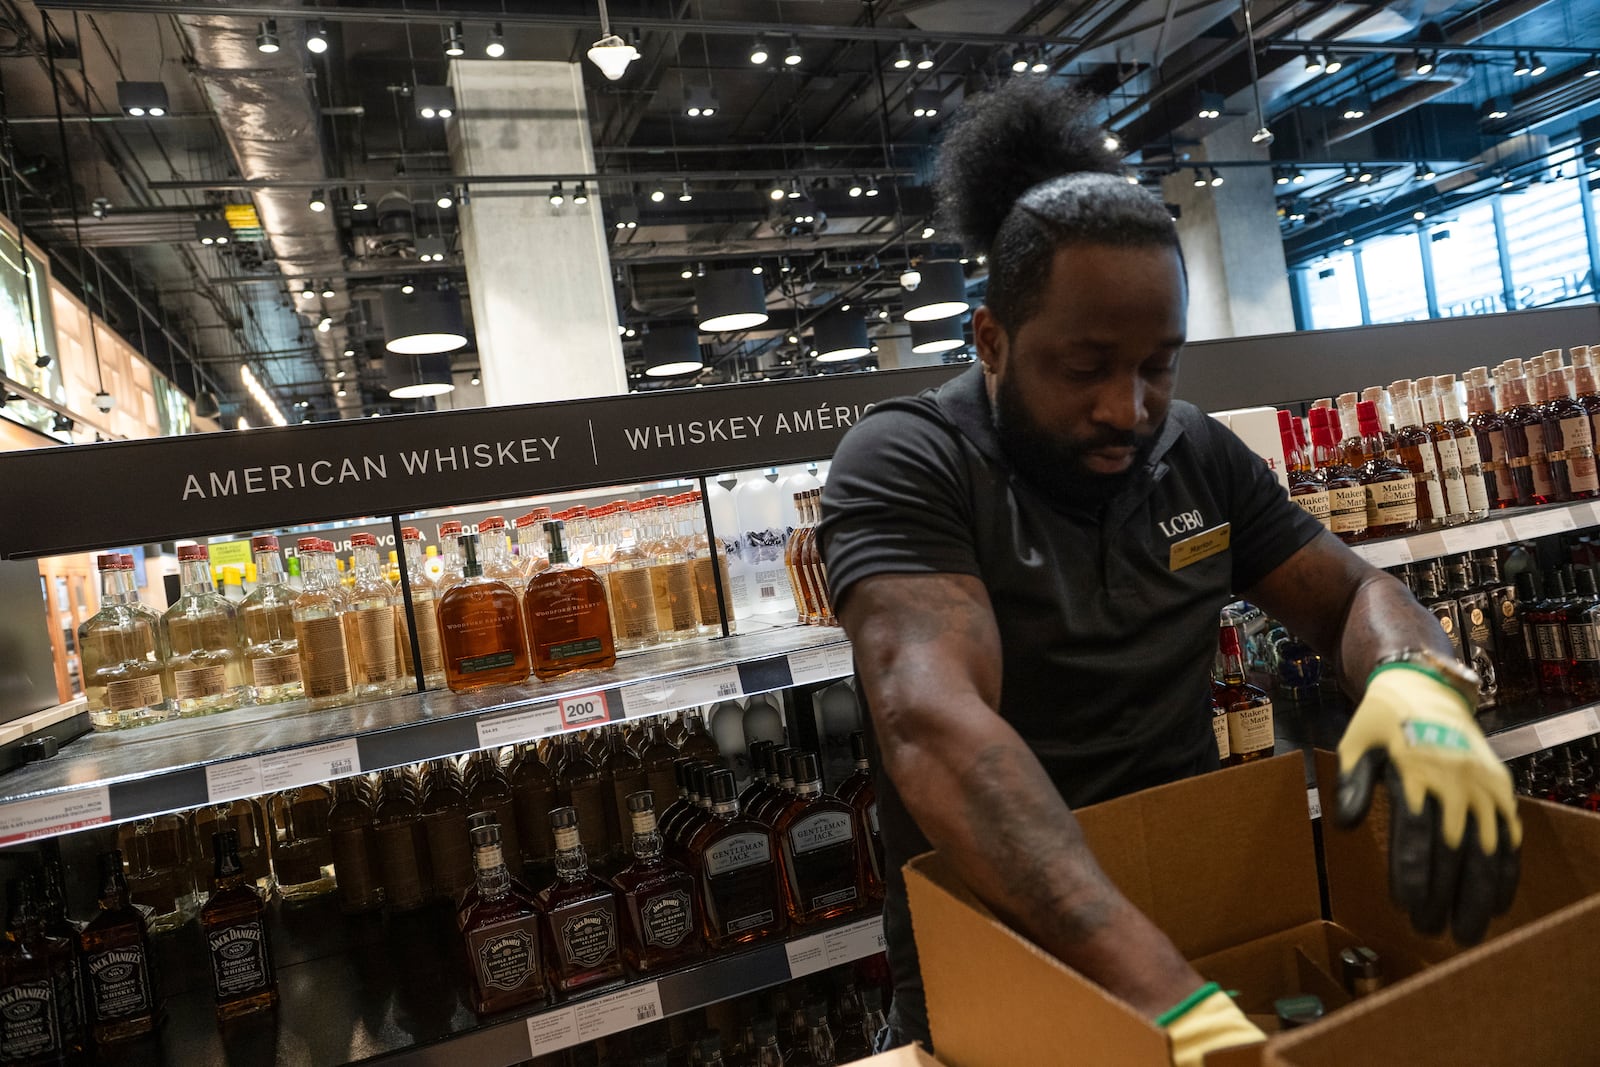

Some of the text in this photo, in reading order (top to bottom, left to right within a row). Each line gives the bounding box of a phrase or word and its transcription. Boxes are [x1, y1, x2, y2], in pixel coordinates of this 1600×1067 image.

[624, 414, 764, 450] WHISKEY
[182, 436, 560, 500] AMERICAN WHISKEY
[1297, 496, 1328, 505] Maker's
[1394, 490, 1416, 500] Mark
[1309, 504, 1329, 512] Mark
[1158, 509, 1204, 538] LCBO
[567, 702, 594, 718] 200
[1240, 708, 1269, 719] Maker's
[1249, 715, 1270, 725] Mark
[797, 820, 846, 838] GENTLEMAN
[814, 831, 833, 840] JACK
[712, 840, 764, 860] GENTLEMAN
[730, 852, 750, 861] JACK
[210, 928, 261, 950] JACK DANIEL'S
[221, 956, 256, 968] Tennessee
[508, 952, 528, 960] BARREL
[88, 952, 142, 974] JACK DANIEL'S
[224, 963, 256, 976] WHISKEY
[102, 988, 136, 999] WHISKEY
